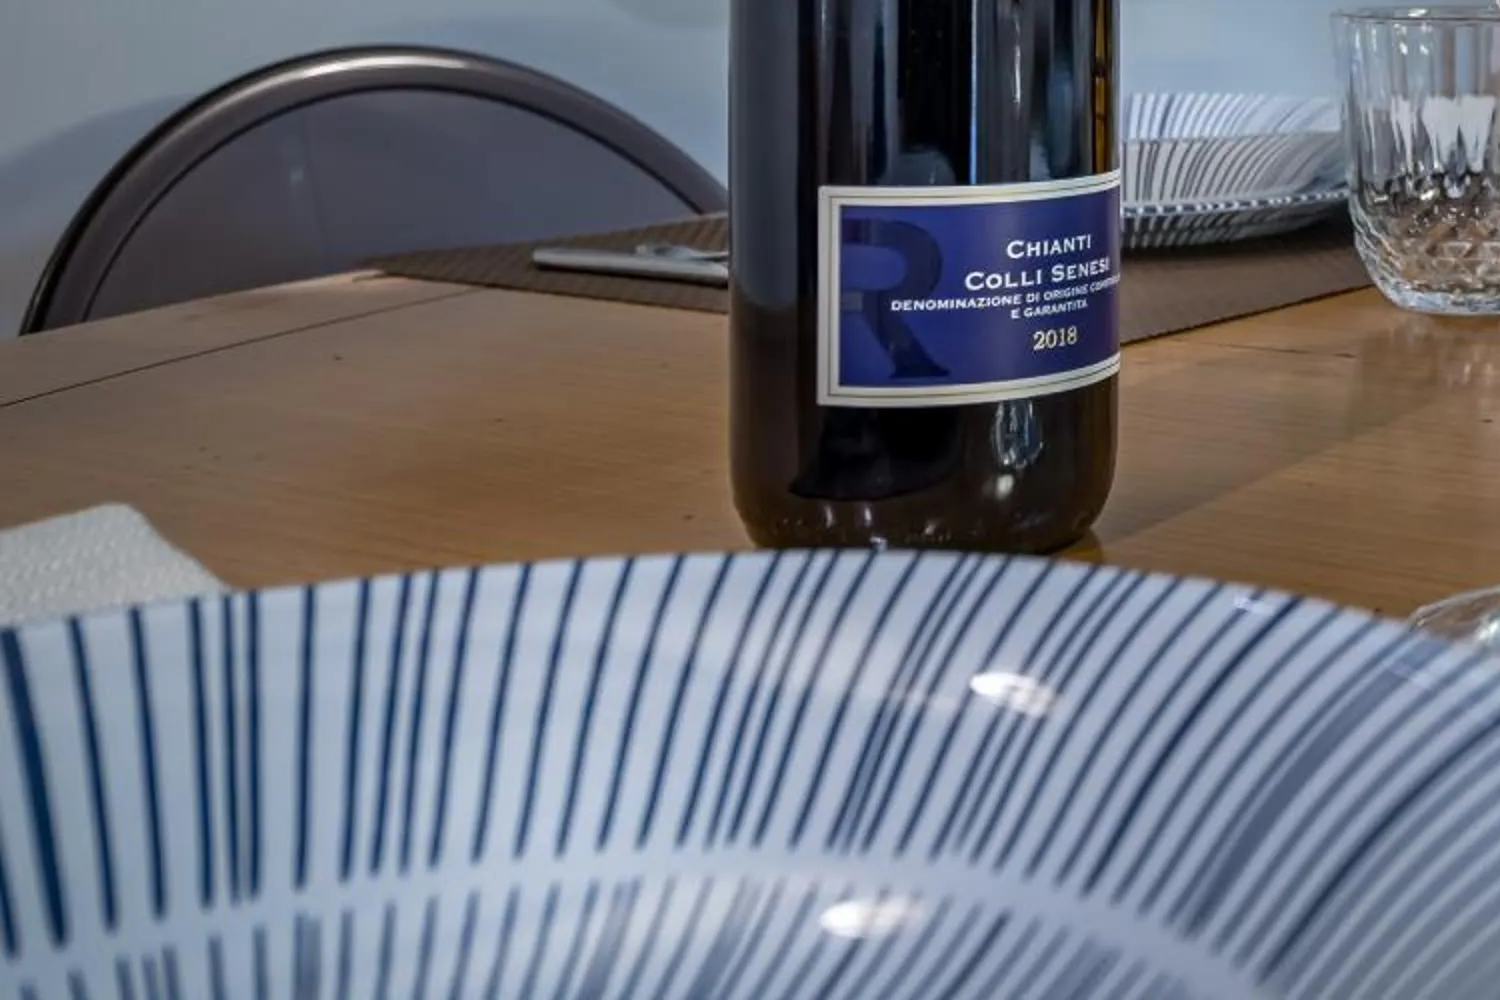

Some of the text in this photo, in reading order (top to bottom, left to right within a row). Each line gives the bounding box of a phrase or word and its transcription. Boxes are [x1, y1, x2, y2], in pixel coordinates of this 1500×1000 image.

[891, 284, 1089, 311] DENOMINAZIONE DI ORIGINE
[1010, 306, 1021, 319] E
[1033, 325, 1077, 350] 2018
